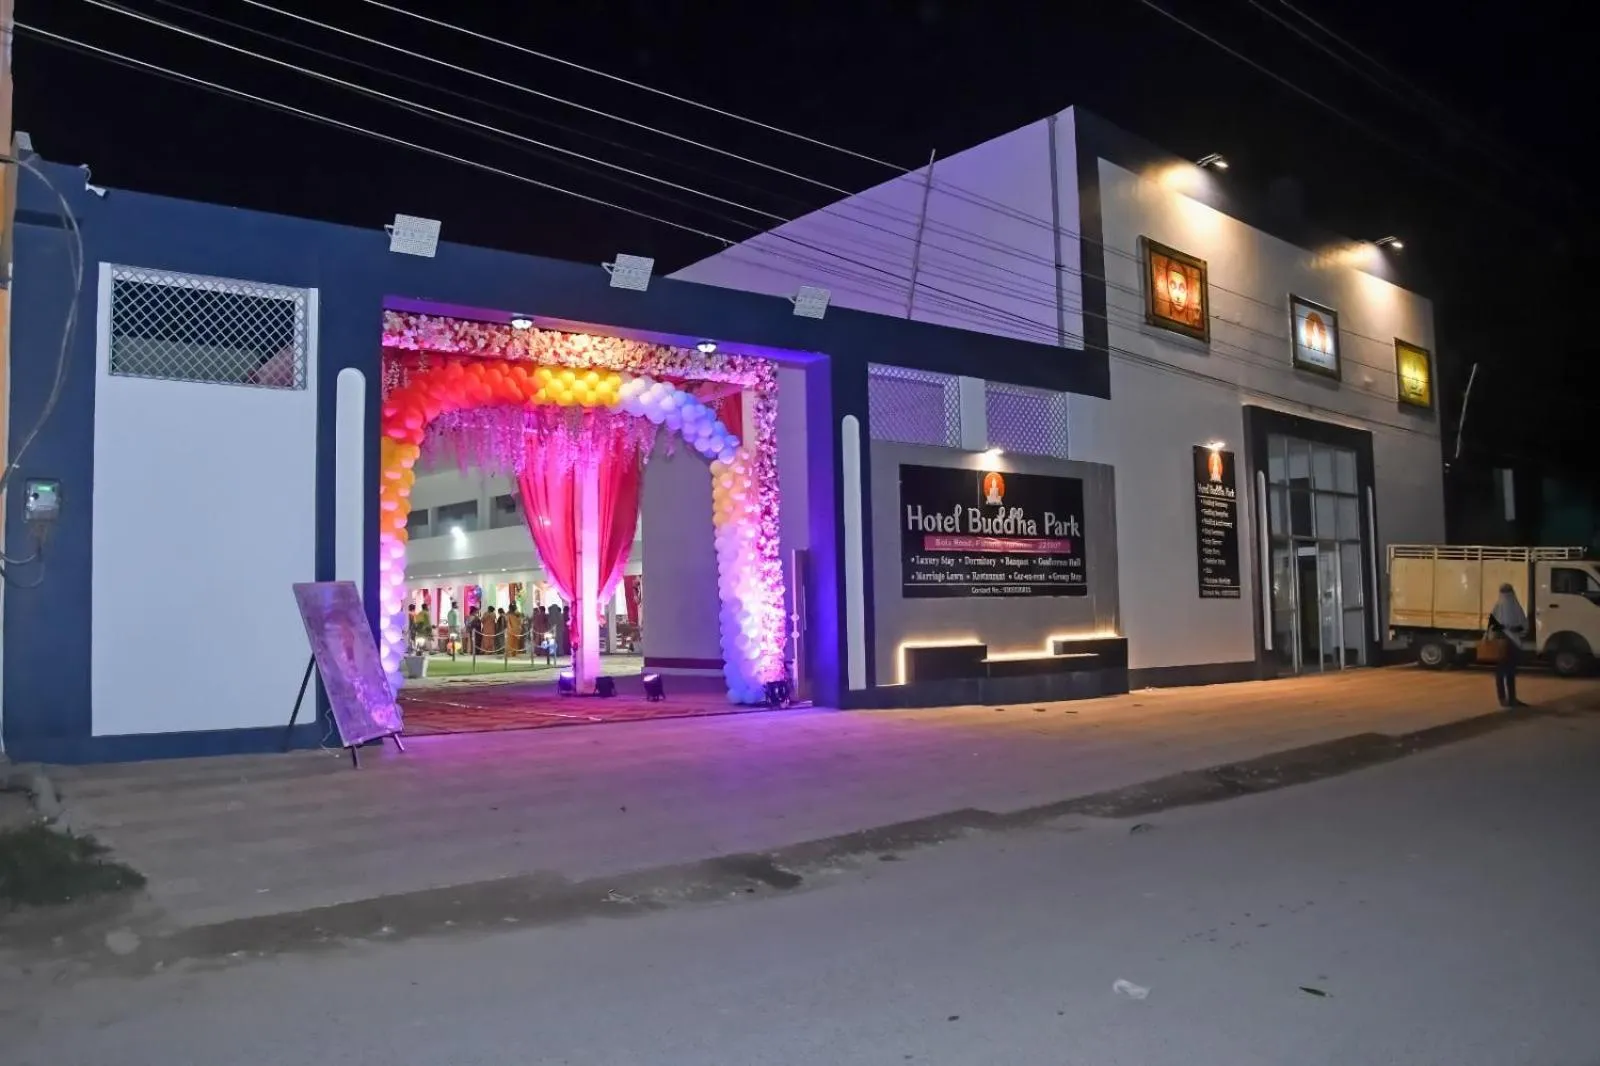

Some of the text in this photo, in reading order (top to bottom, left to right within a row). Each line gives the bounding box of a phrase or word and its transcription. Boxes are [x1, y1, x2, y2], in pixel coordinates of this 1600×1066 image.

[907, 504, 1081, 537] Hotel Buddha Park
[915, 555, 939, 567] Luxury
[941, 556, 955, 567] Stay
[964, 556, 996, 568] Dormitory
[1068, 558, 1081, 567] Hall
[915, 571, 945, 582] Marriage
[946, 571, 963, 581] Lawn
[971, 571, 1005, 581] Restaurant
